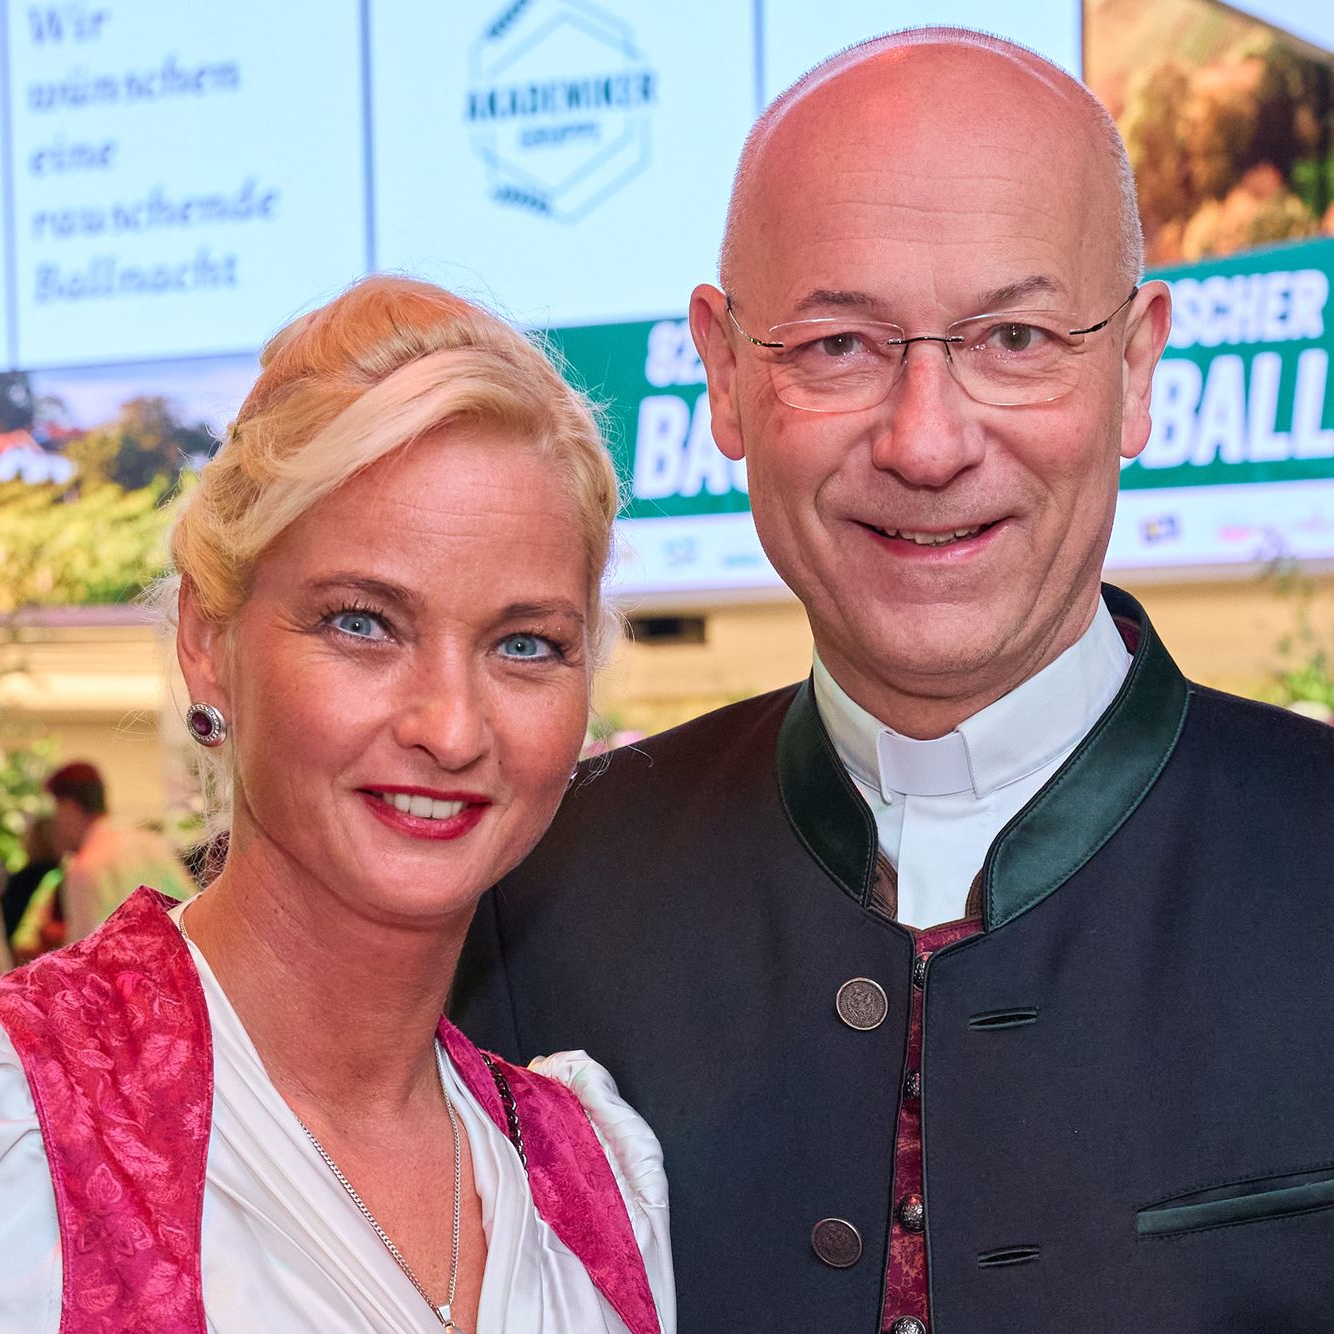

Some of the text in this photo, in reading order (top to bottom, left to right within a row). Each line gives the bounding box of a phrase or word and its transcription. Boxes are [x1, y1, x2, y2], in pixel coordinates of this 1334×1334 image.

[28, 6, 110, 46] Wir
[28, 54, 242, 112] wünschen
[29, 133, 117, 178] eine
[31, 174, 279, 240] rauschende
[34, 247, 240, 305] Ballnacht
[1166, 270, 1329, 349] SCHER
[634, 394, 749, 500] BA
